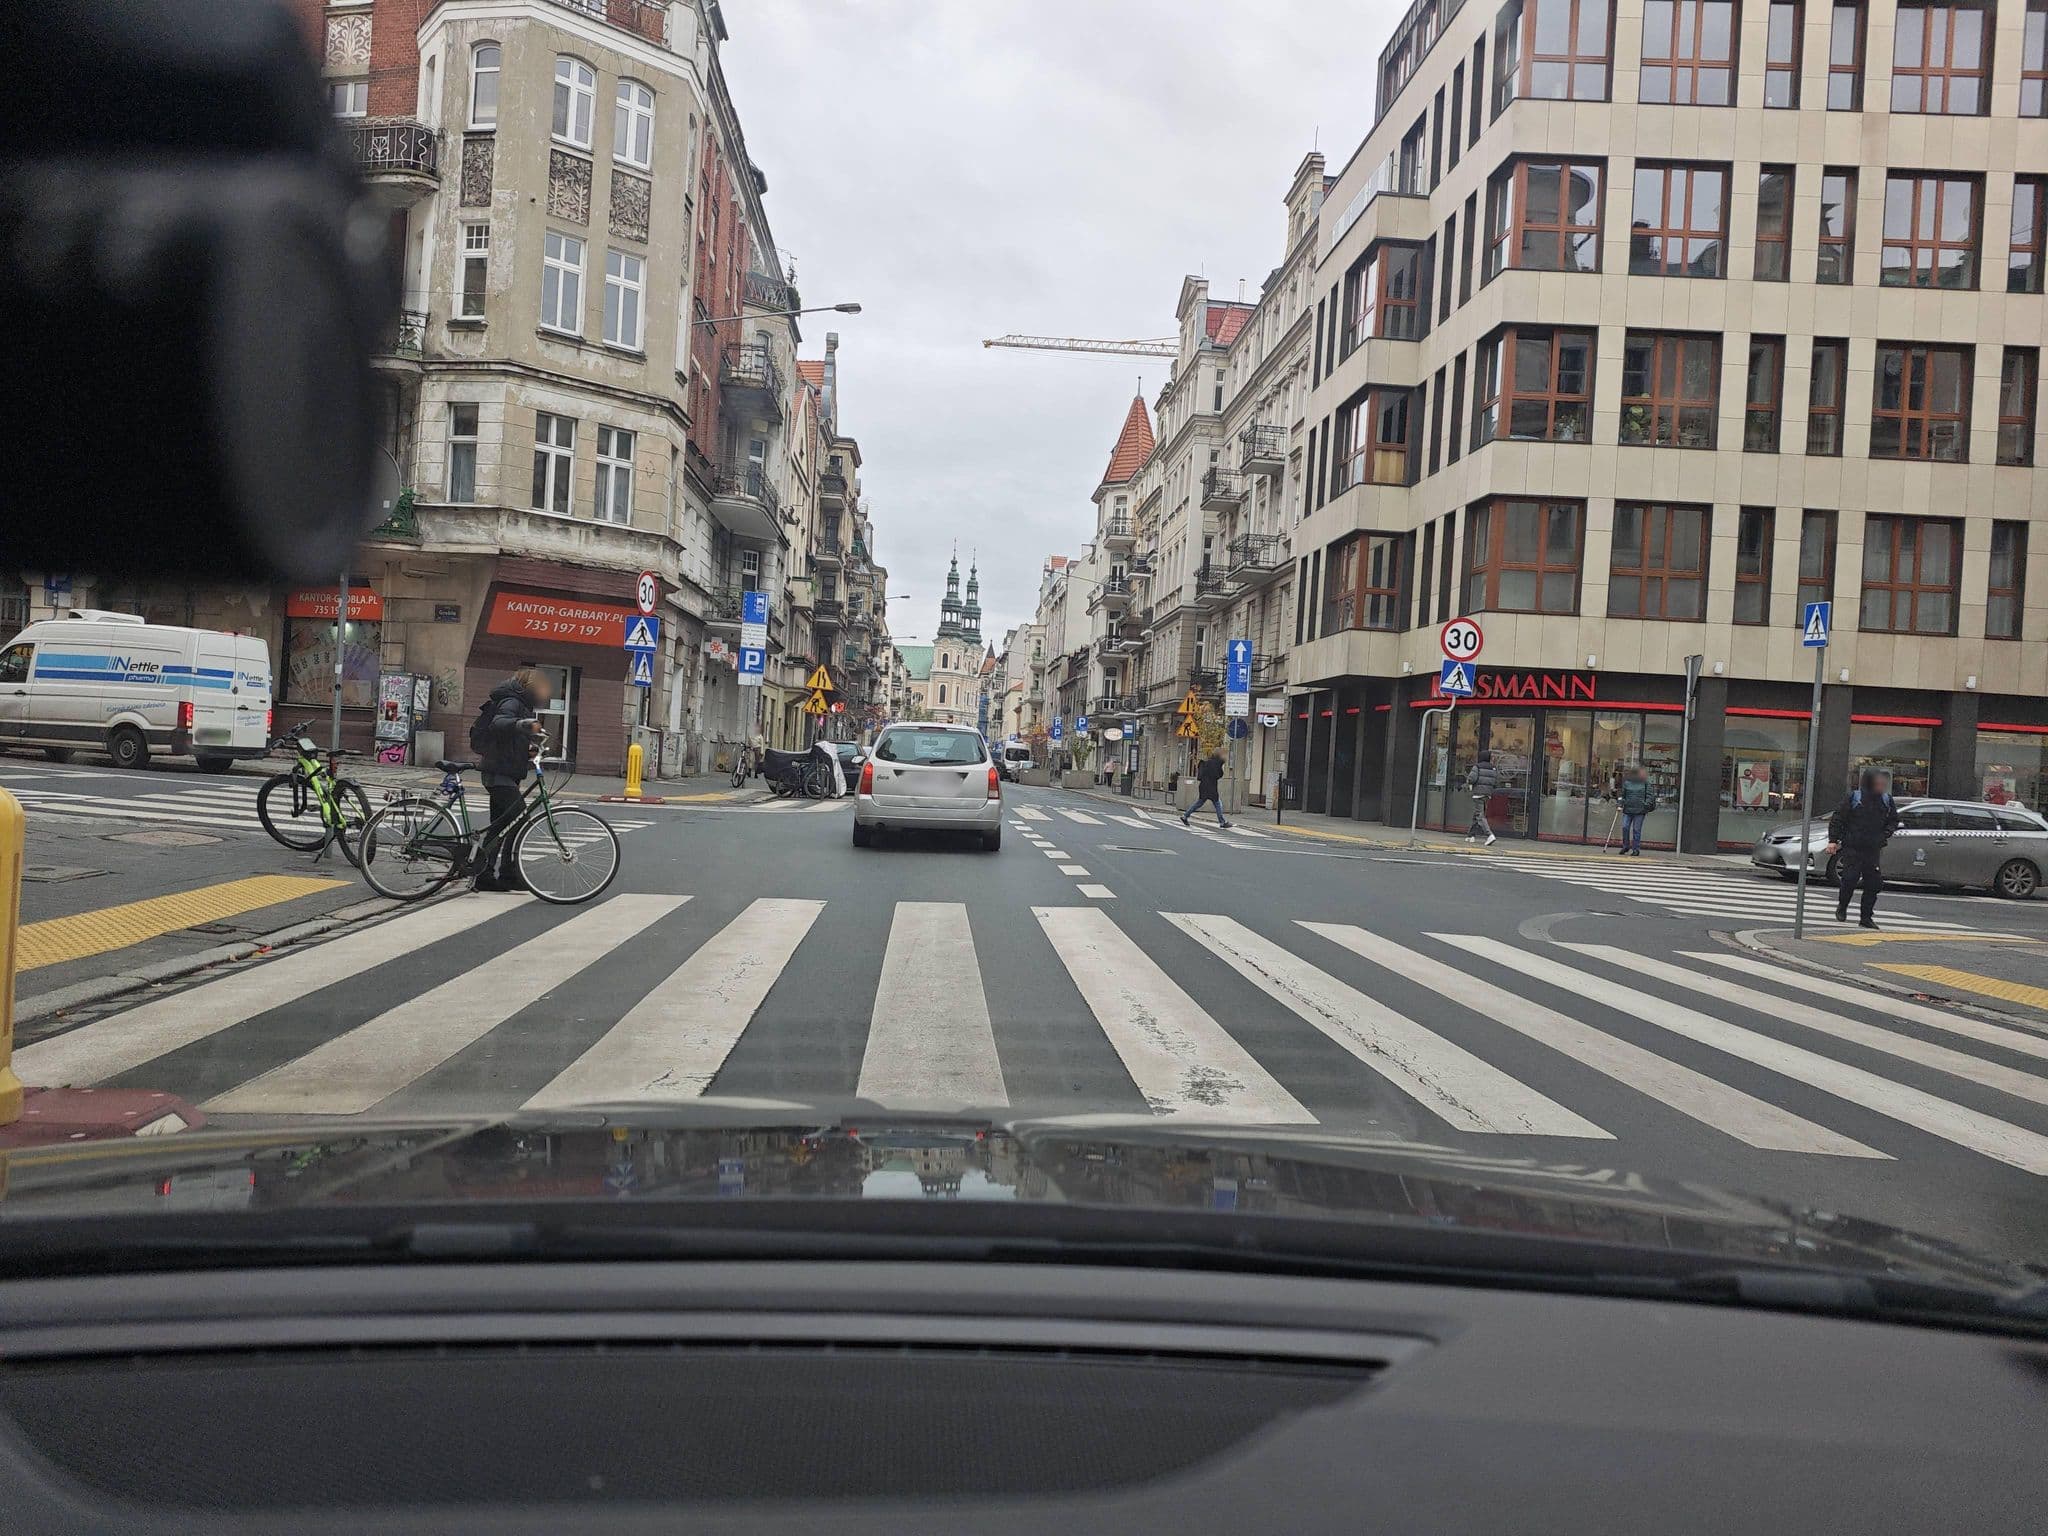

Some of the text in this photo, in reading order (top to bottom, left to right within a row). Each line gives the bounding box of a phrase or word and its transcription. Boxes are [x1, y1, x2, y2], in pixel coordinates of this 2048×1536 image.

[639, 581, 654, 606] 30
[314, 605, 329, 614] 735
[347, 607, 361, 615] 197
[507, 600, 625, 624] KANTOR-GARBARY.PL
[524, 618, 602, 636] 735 197 197
[1447, 628, 1477, 651] 30
[115, 656, 160, 673] Nettle
[744, 650, 761, 671] P
[1431, 674, 1597, 700] RSMANN
[1078, 717, 1086, 727] P
